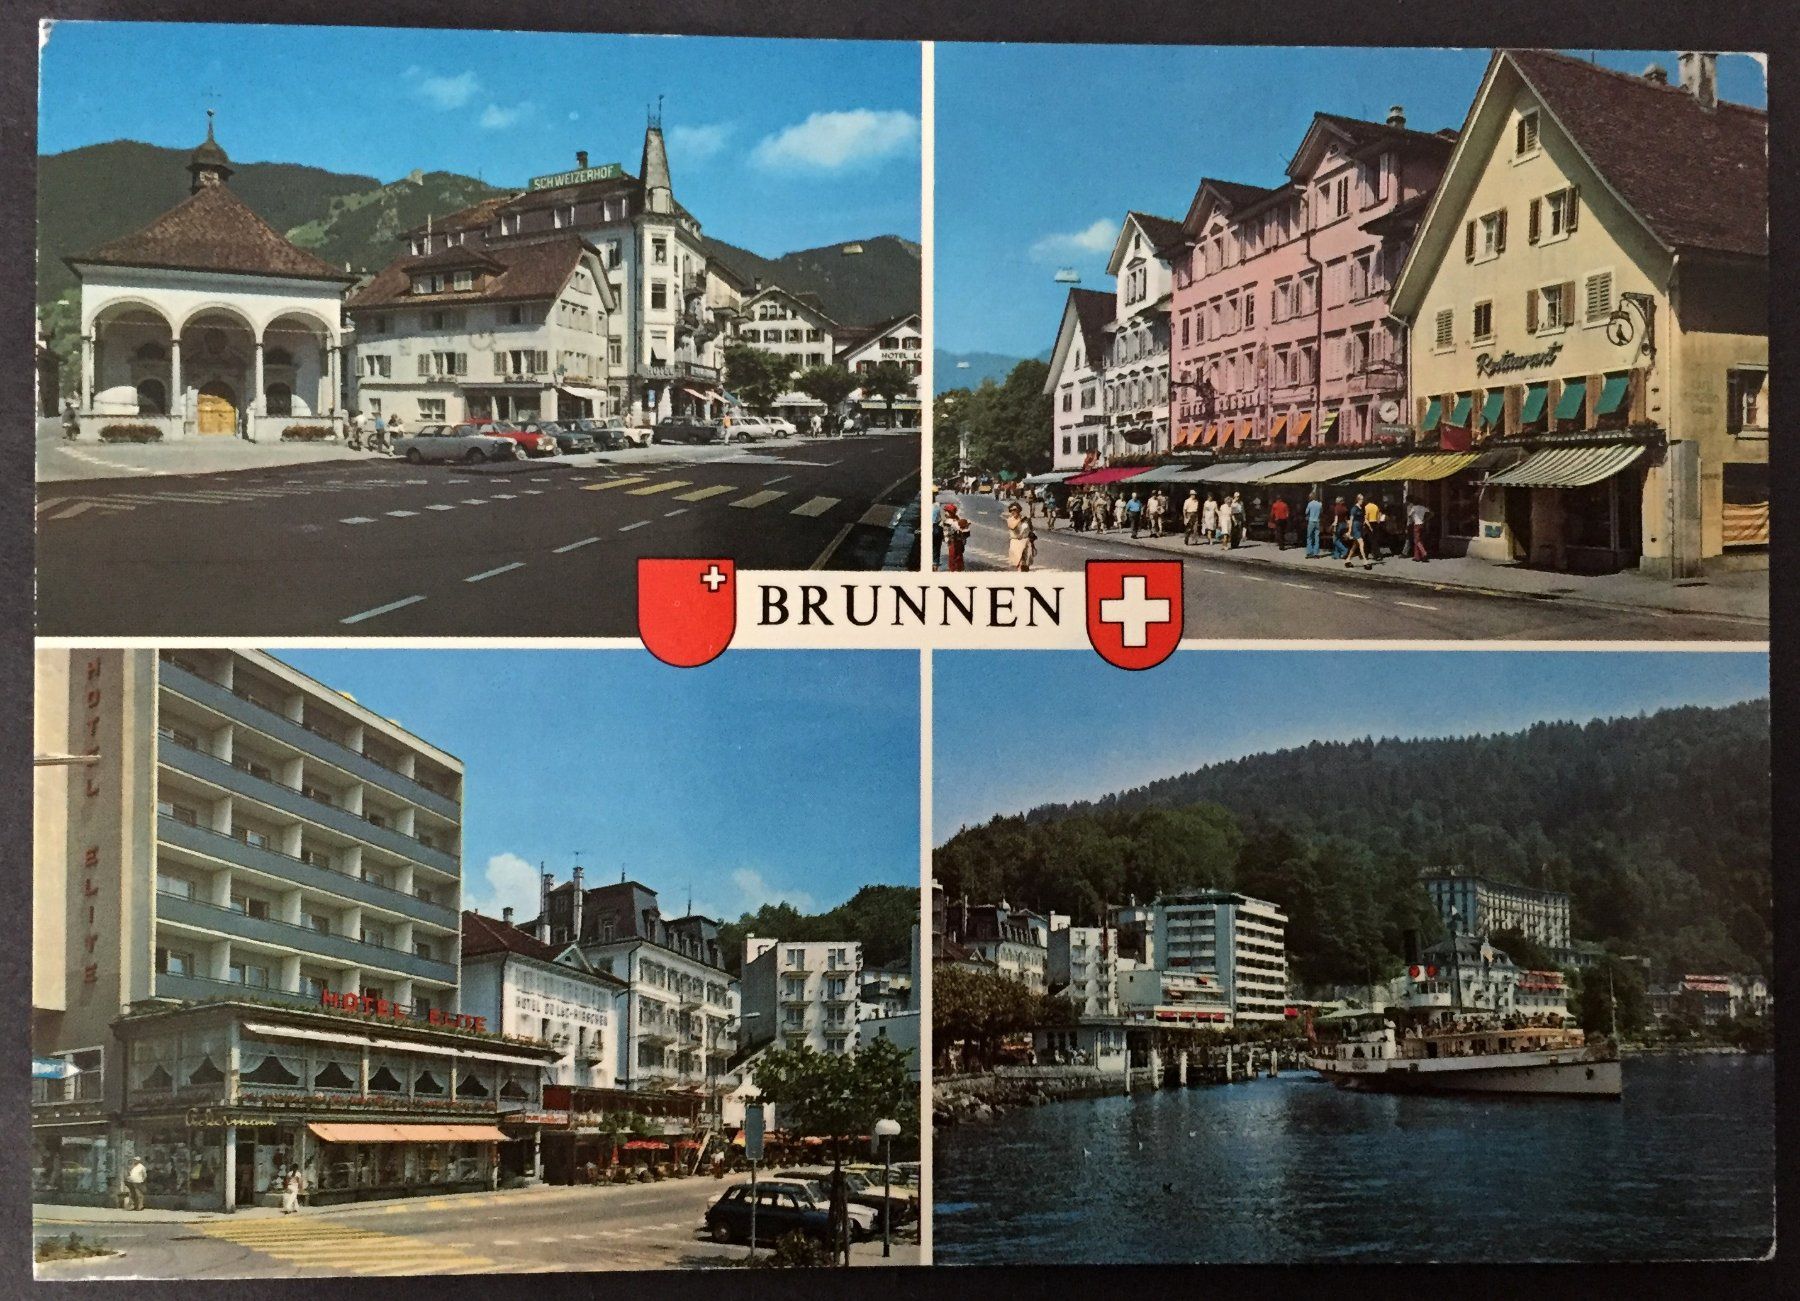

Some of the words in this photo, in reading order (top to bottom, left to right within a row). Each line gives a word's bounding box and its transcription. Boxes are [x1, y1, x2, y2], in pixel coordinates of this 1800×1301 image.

[533, 165, 614, 190] SCHWEIZERHOF
[1476, 341, 1563, 378] Restaurant
[756, 584, 1065, 628] BRUNNEN
[84, 845, 100, 986] ELITE
[321, 987, 408, 1021] HOTEL
[428, 1007, 488, 1033] ELITE
